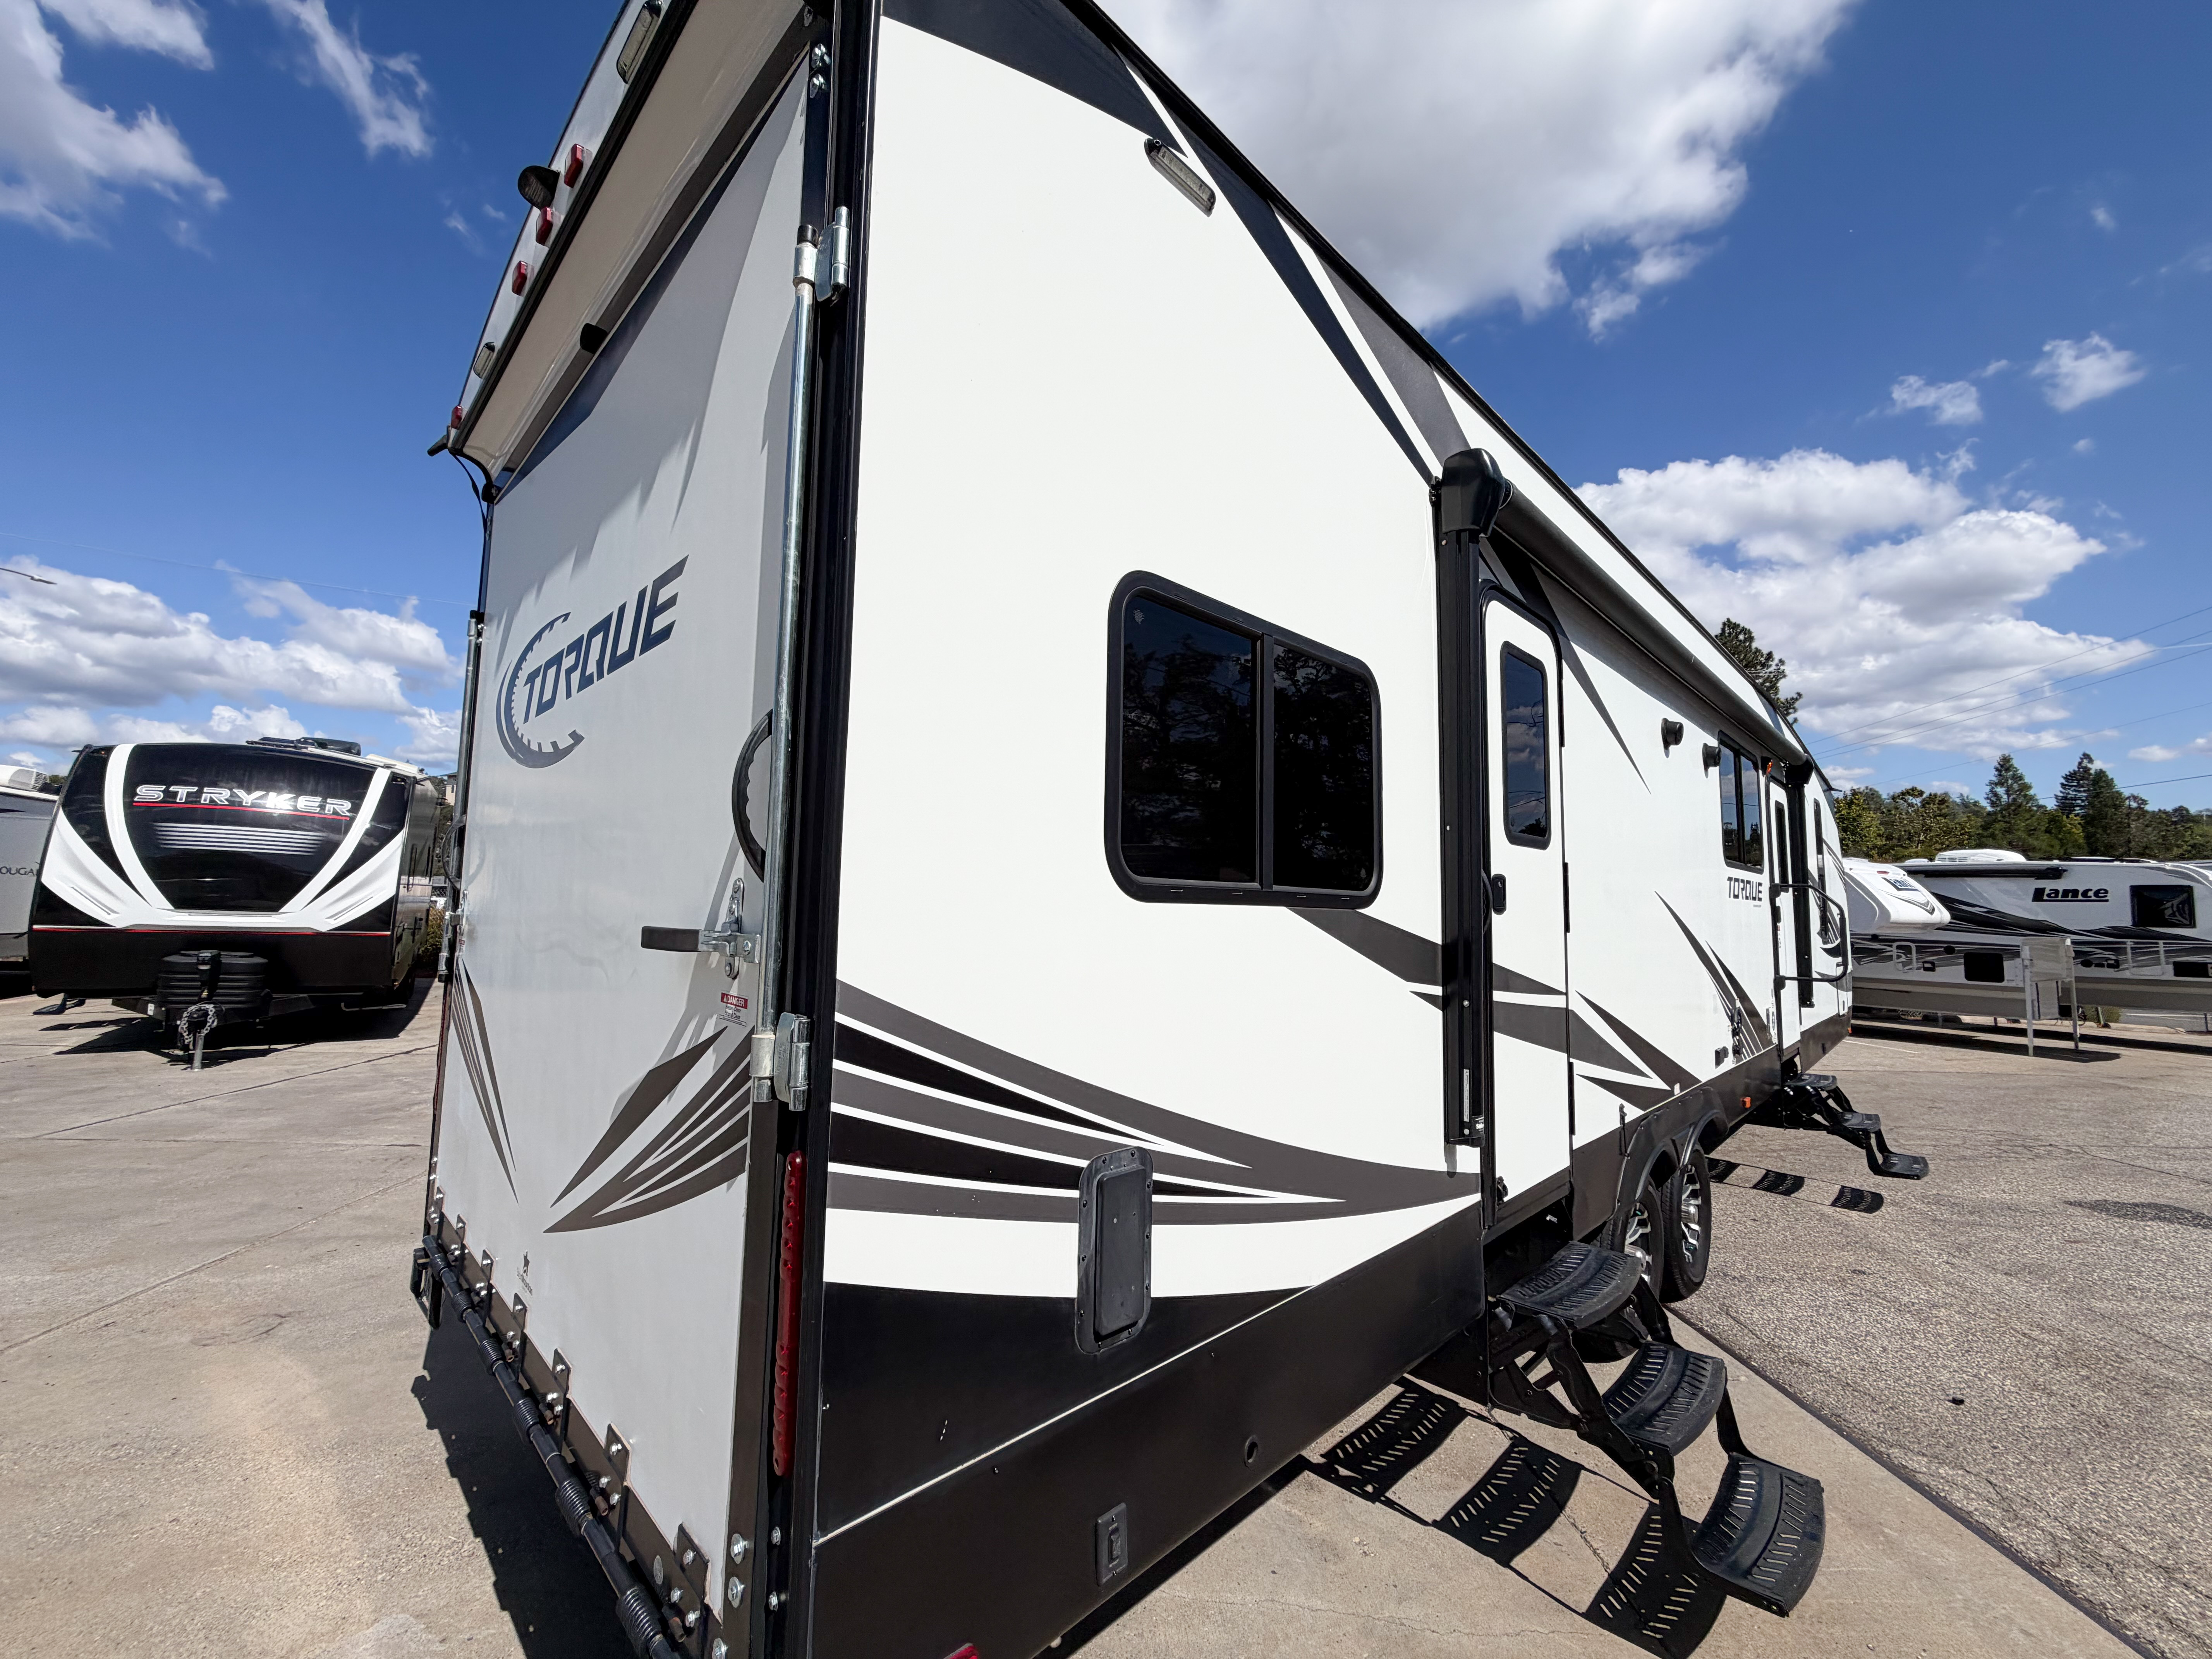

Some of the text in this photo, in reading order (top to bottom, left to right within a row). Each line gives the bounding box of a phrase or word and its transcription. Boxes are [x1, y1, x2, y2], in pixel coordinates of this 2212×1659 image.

[523, 554, 689, 724] TORQUE
[134, 785, 352, 816] STRYKER
[0, 866, 39, 877] OUGA
[1727, 876, 1763, 902] TORQUE
[727, 995, 744, 1007] DANGER
